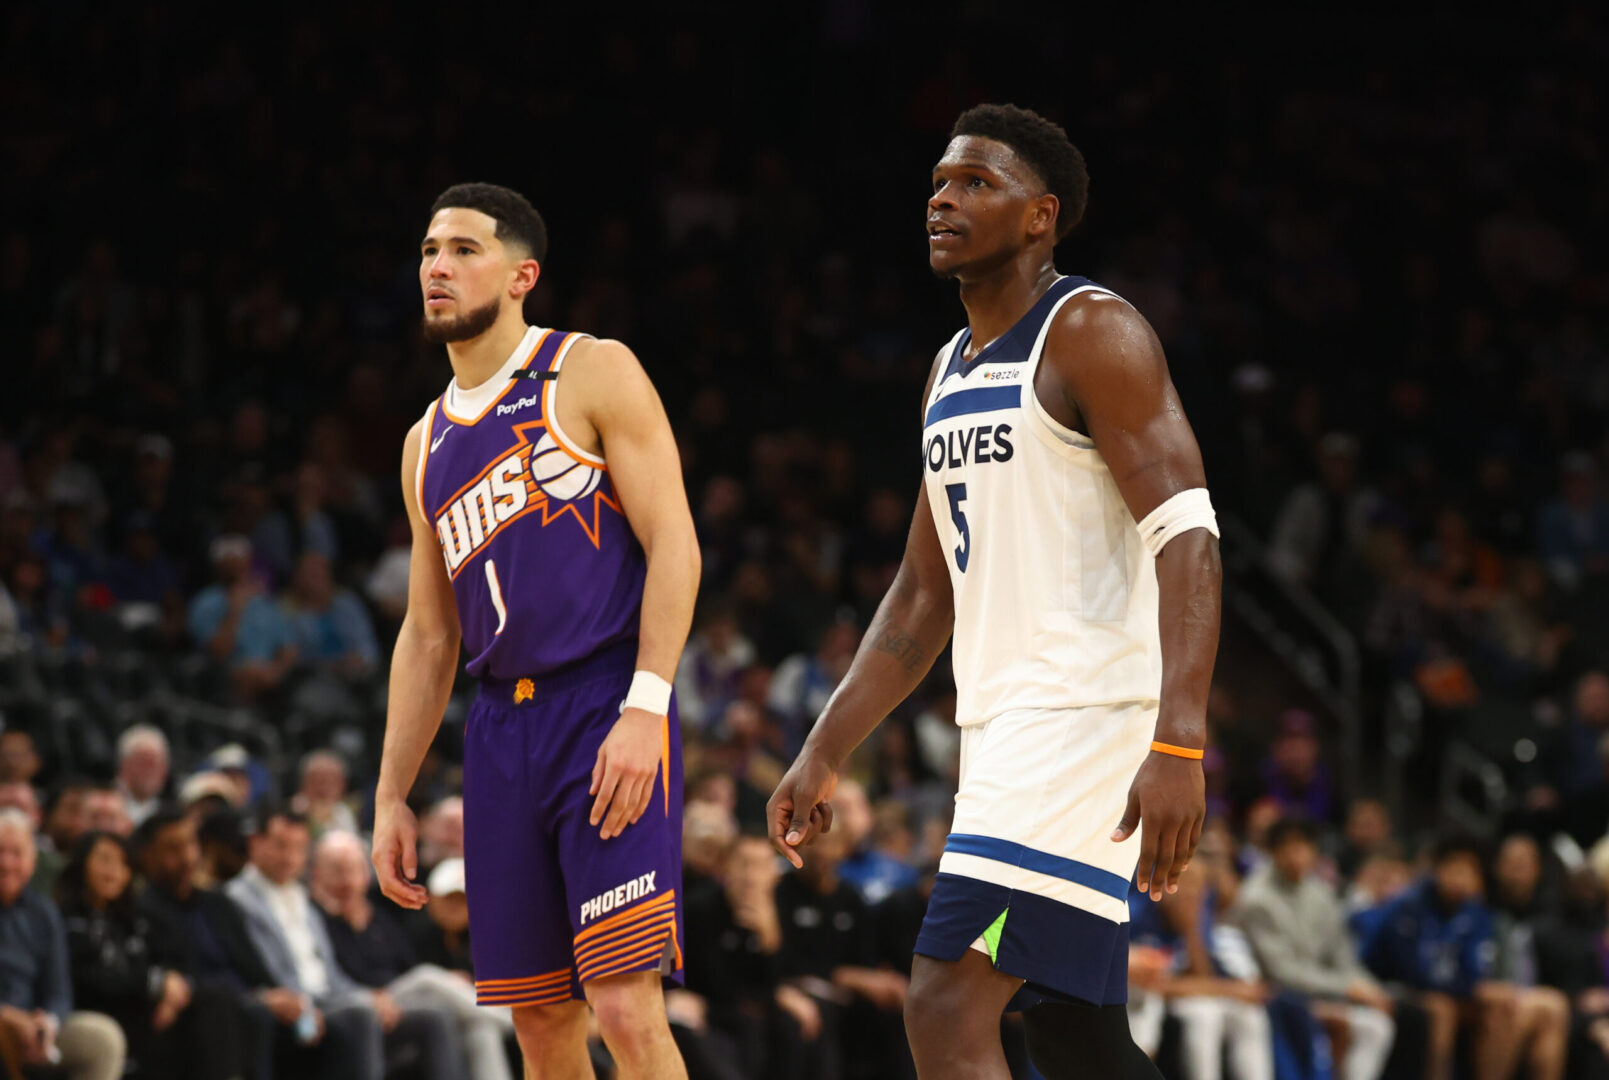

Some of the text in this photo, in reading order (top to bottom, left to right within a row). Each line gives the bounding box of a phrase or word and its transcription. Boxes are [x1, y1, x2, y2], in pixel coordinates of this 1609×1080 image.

[497, 394, 537, 417] PayPal
[991, 369, 1020, 380] sezzle
[437, 455, 528, 581] UNS
[945, 482, 970, 574] 5
[485, 559, 507, 636] 1
[581, 870, 656, 925] PHOENIX
